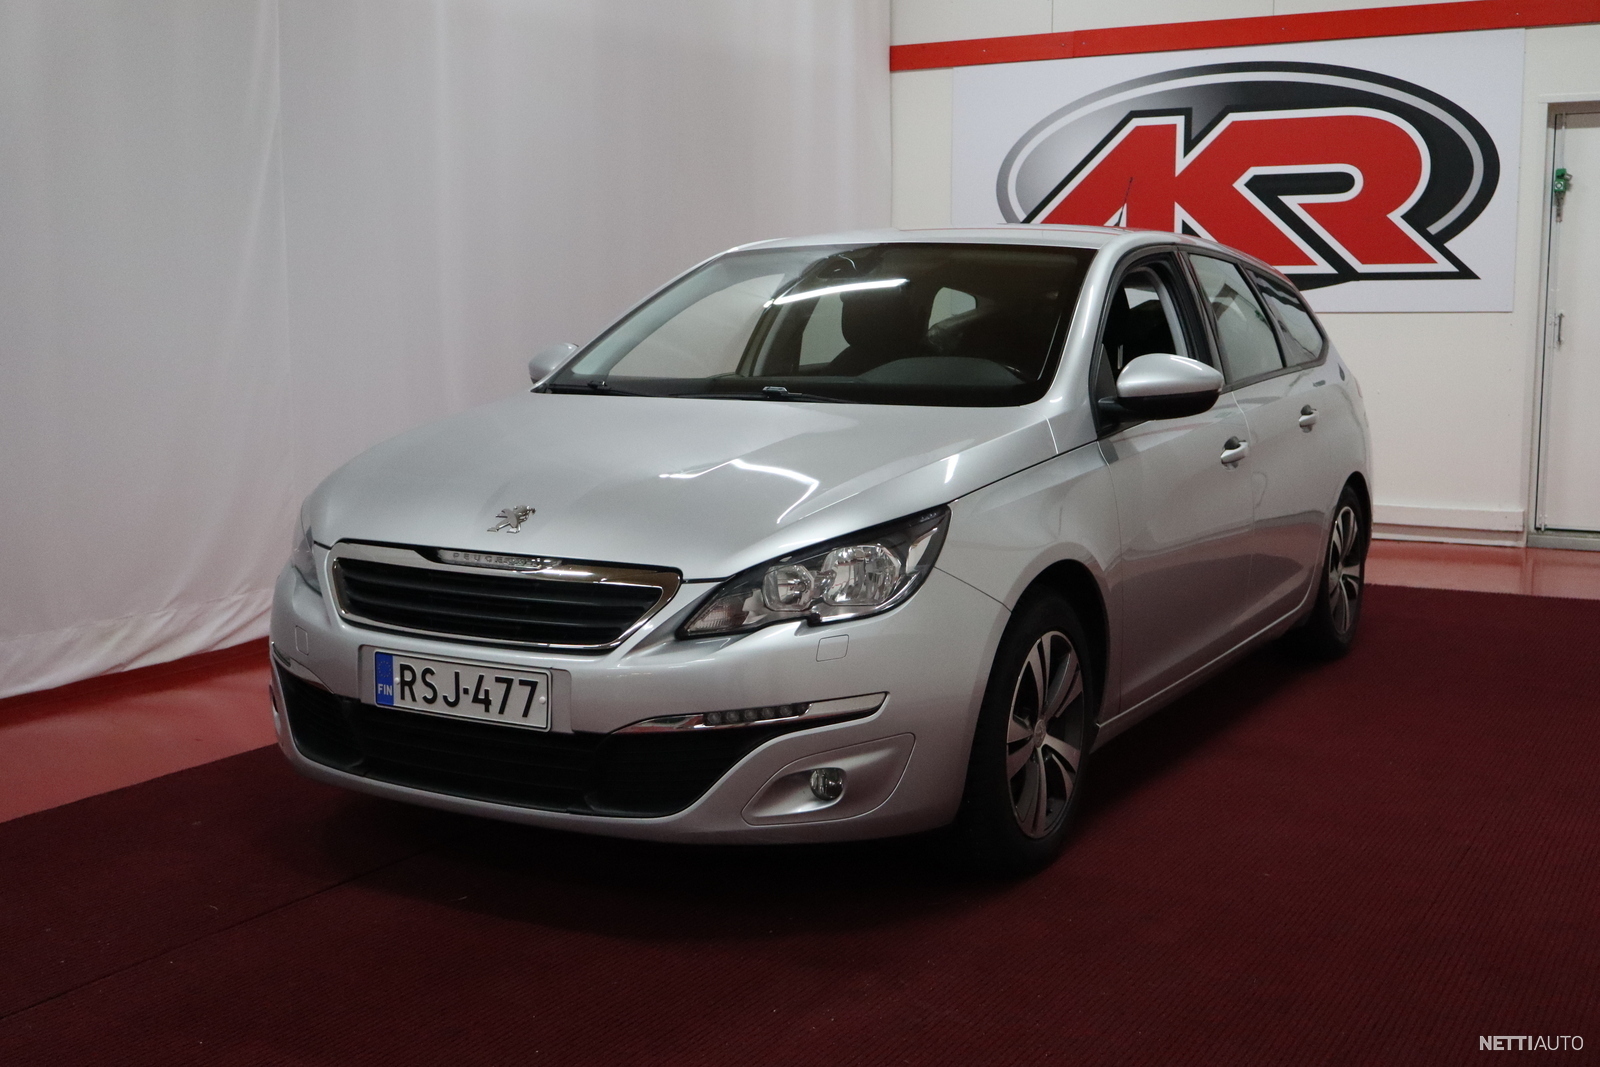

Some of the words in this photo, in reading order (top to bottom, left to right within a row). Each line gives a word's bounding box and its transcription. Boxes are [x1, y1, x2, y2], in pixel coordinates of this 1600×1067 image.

[453, 552, 525, 566] PEUGE
[377, 683, 393, 697] FIN
[399, 663, 539, 718] RSJ-477
